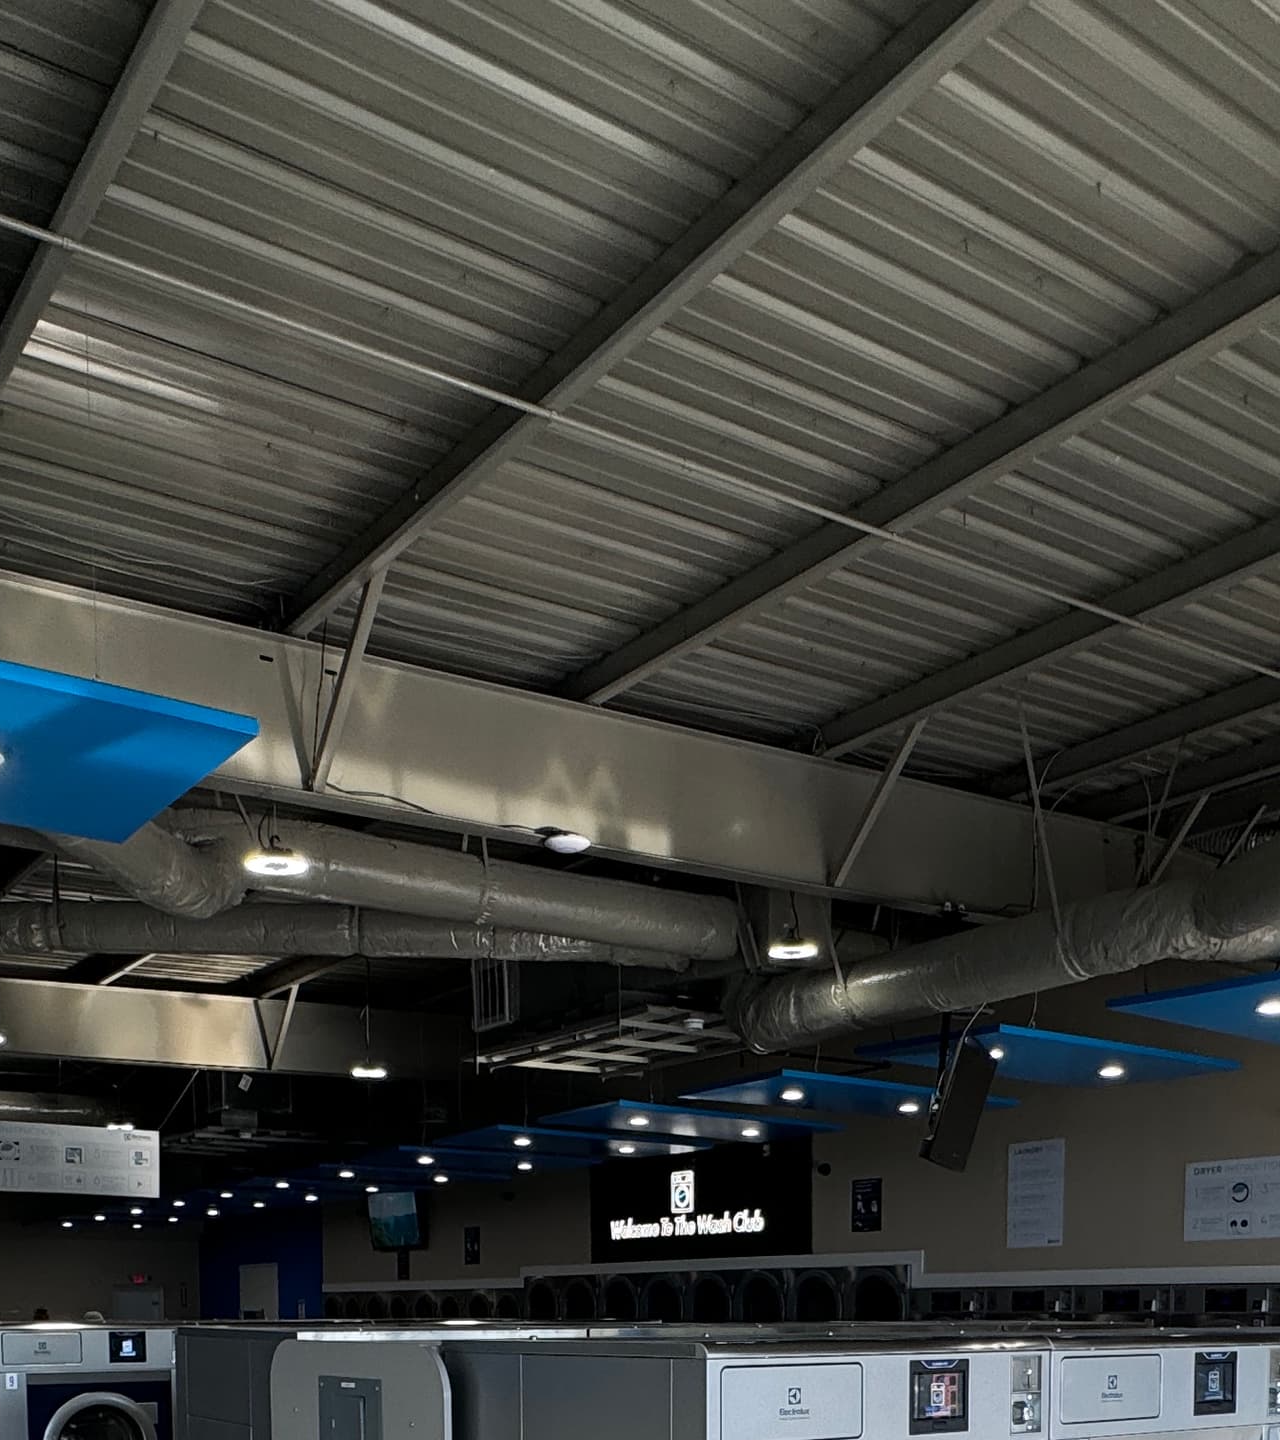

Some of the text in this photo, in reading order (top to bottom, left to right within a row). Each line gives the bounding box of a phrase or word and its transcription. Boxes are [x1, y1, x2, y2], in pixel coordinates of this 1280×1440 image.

[1193, 1165, 1223, 1176] DRYER
[610, 1208, 765, 1240] Welcome To The Wash Club
